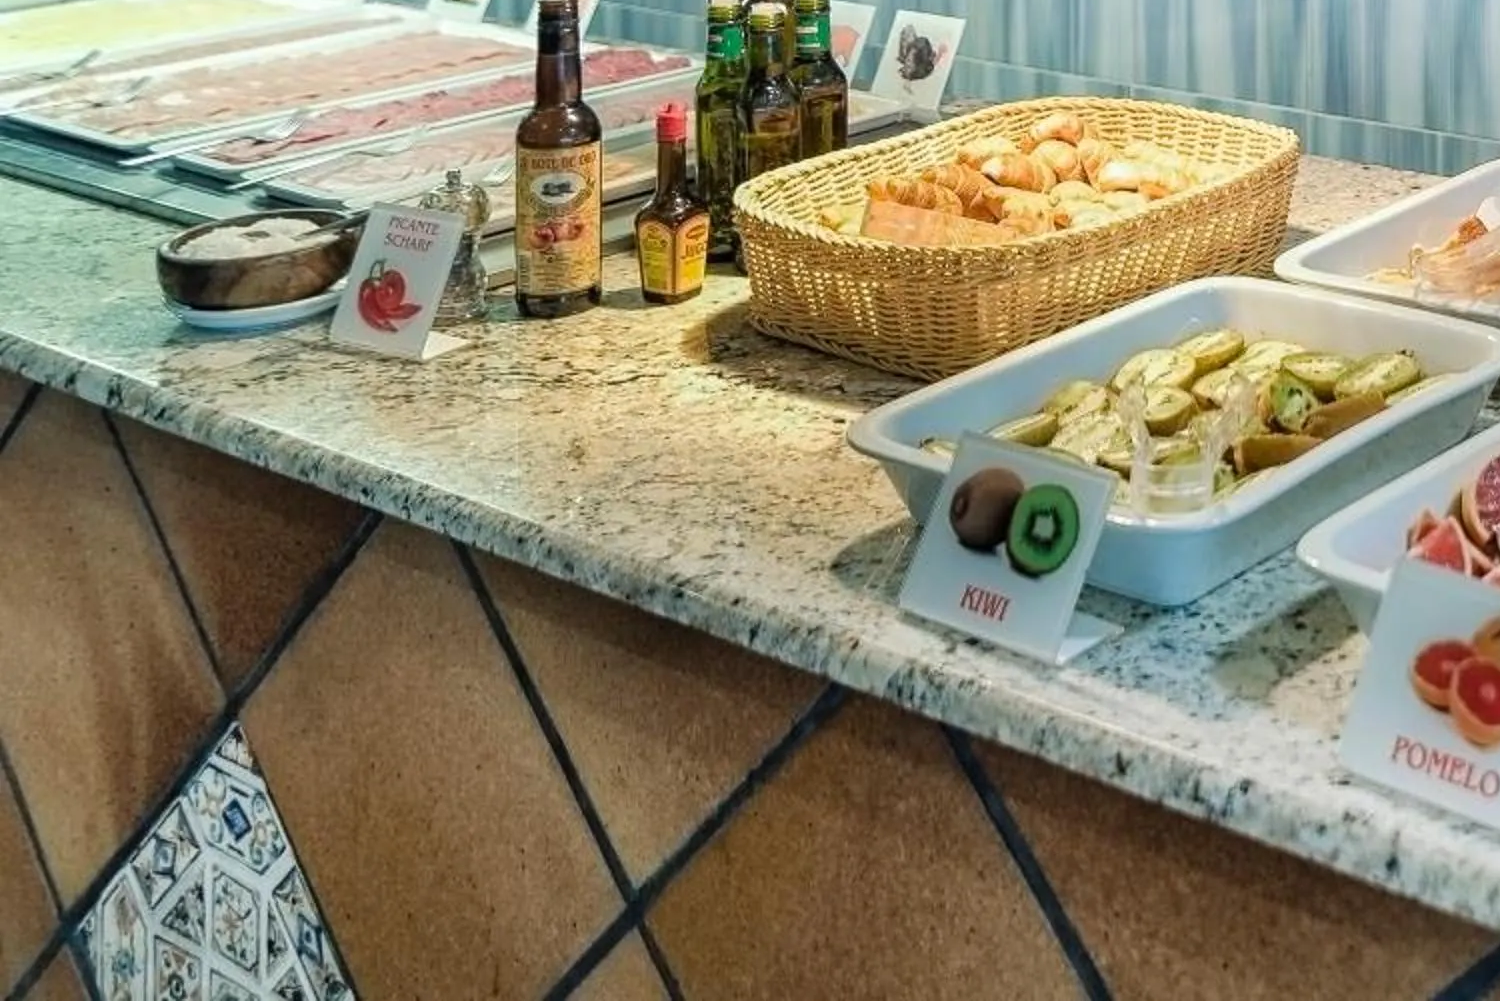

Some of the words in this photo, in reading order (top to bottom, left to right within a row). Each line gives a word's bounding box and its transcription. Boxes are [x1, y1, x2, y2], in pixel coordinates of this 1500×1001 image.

[389, 216, 441, 236] PICANTE
[384, 233, 434, 252] SCHARF
[960, 583, 1010, 621] KIWI
